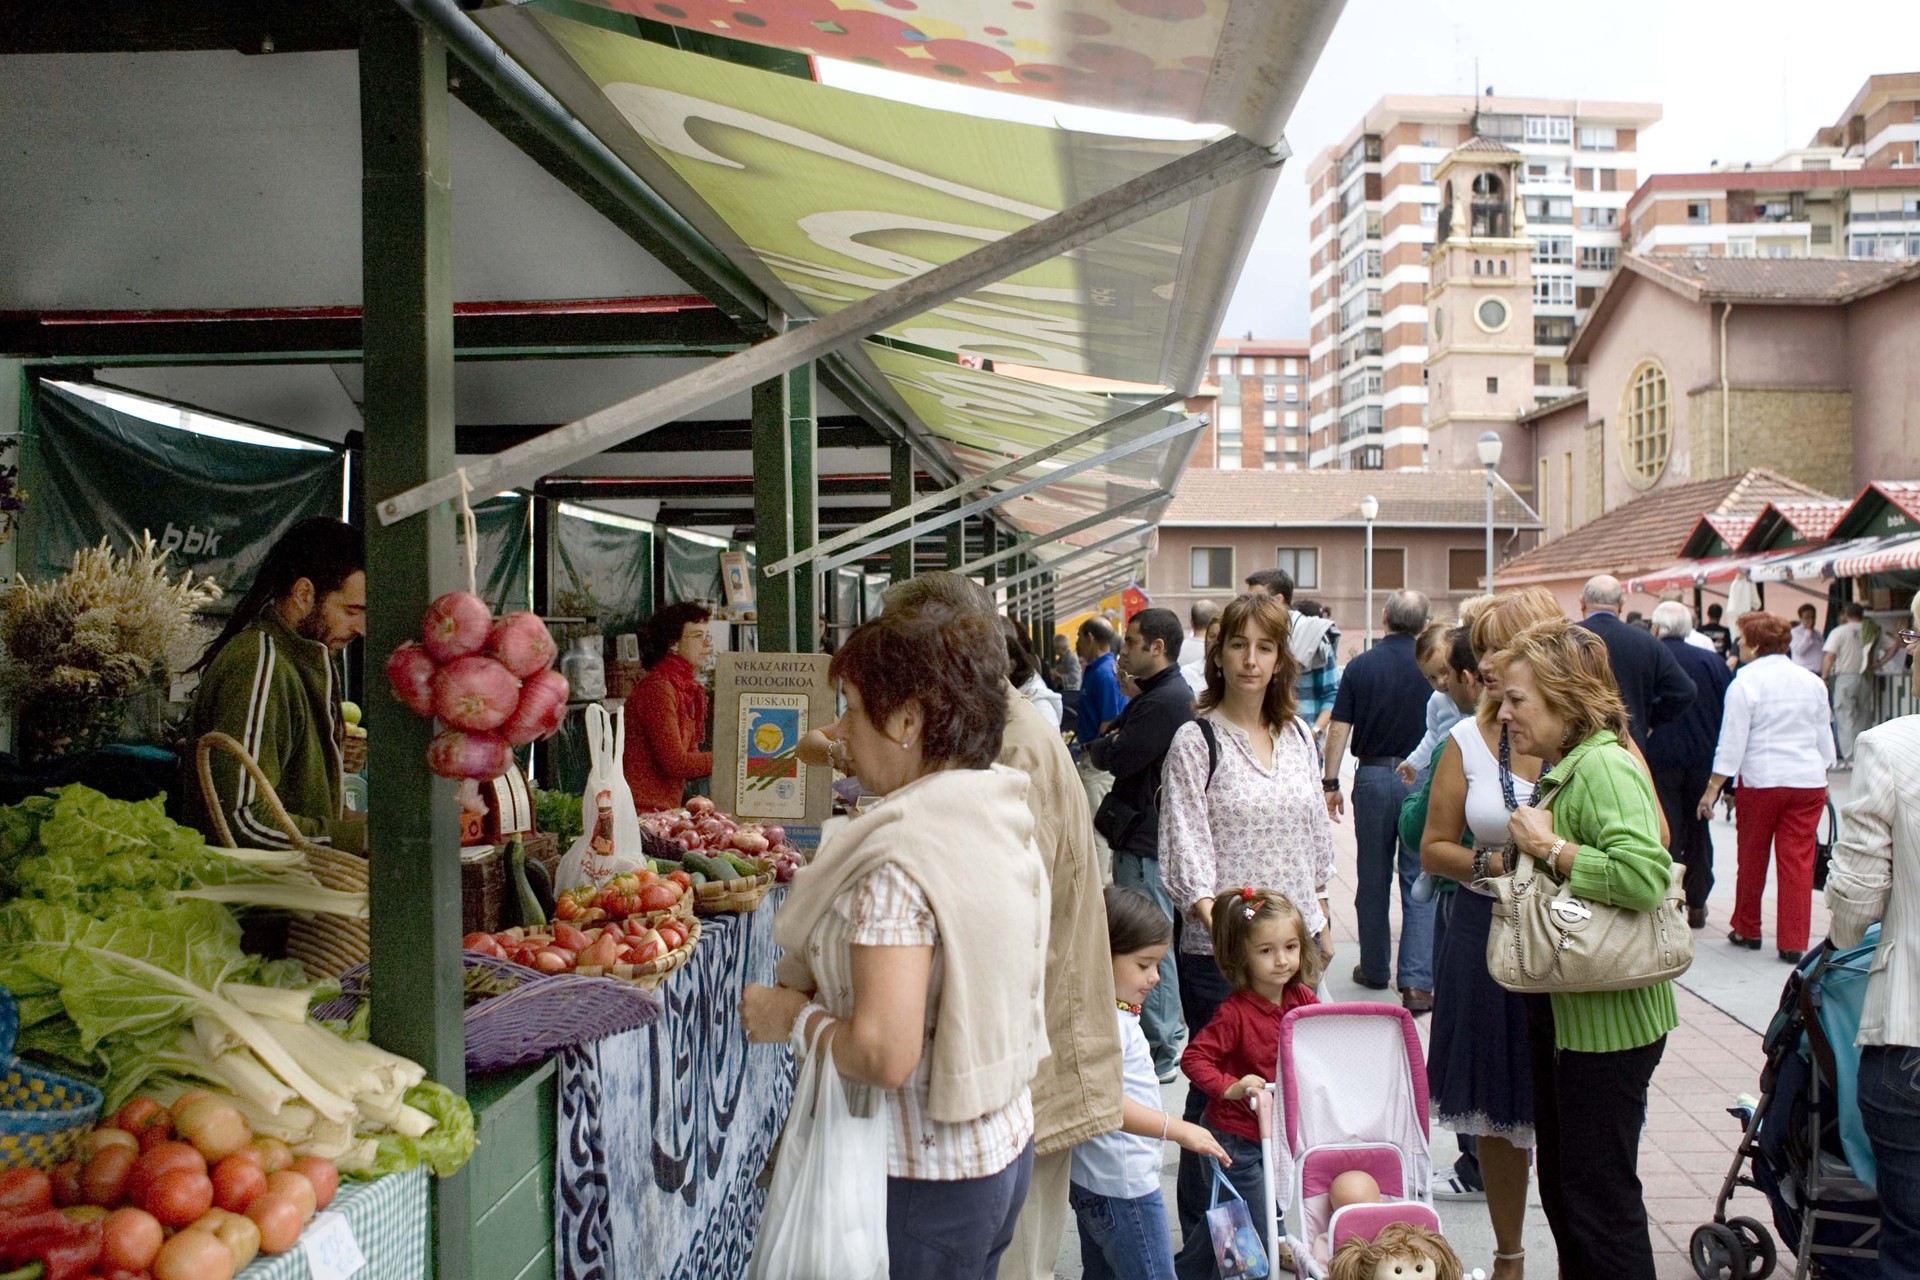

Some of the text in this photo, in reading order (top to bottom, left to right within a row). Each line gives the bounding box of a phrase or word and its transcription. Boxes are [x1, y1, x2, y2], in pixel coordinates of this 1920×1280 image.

[1887, 513, 1906, 528] bbk
[160, 522, 222, 556] bbk
[734, 661, 815, 673] NEKAZARITZA
[735, 676, 814, 687] EKOLOGIKOA
[750, 697, 799, 706] EUSKADI
